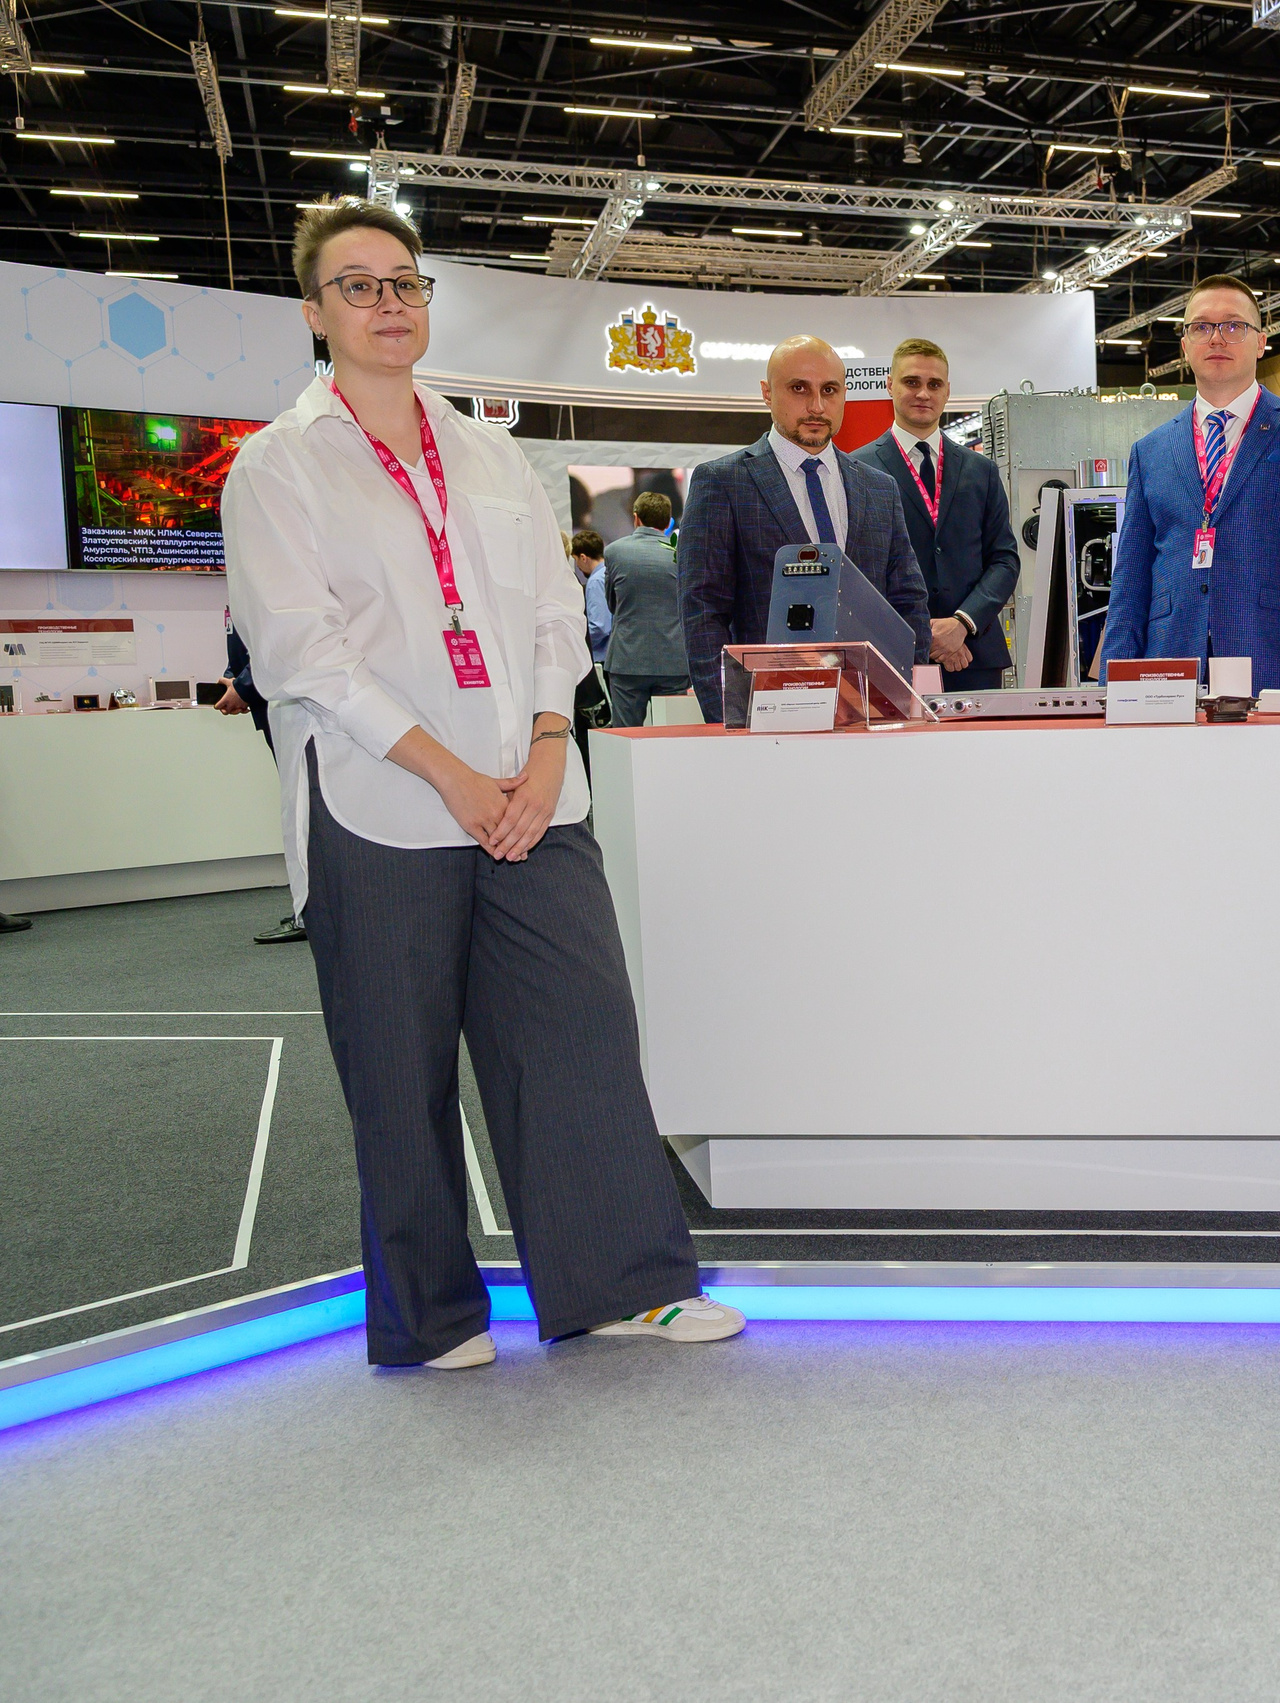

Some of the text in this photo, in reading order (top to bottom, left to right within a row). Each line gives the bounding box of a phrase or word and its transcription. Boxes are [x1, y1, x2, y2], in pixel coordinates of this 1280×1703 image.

[845, 367, 892, 379] ДСТВЕН
[81, 527, 126, 536] Заказчики
[133, 528, 156, 537] ММК,
[157, 529, 185, 538] НЛМК,
[185, 530, 224, 539] Северста
[82, 536, 224, 548] Златоустовский металлургический
[83, 546, 130, 555] Амурсталь,
[131, 547, 156, 555] ЧТПЗ,
[156, 547, 199, 556] Ашинский
[83, 555, 138, 564] Косогорский
[139, 556, 215, 565] металлургический
